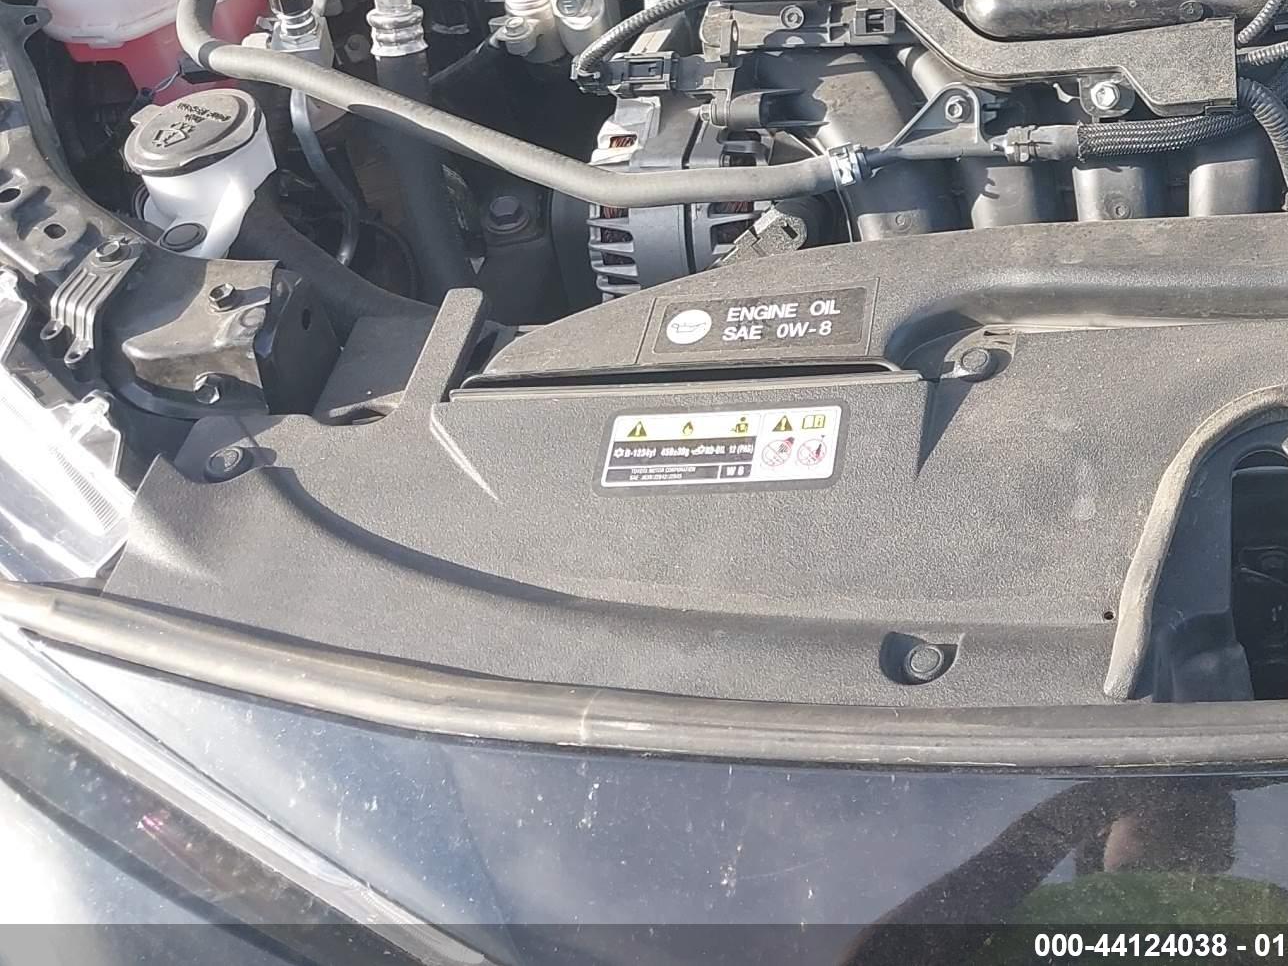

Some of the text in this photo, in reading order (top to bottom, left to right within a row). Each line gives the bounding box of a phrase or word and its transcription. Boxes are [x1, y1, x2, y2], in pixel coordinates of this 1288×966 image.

[727, 299, 841, 322] ENGINE OIL
[722, 320, 833, 341] SAE 0W-8
